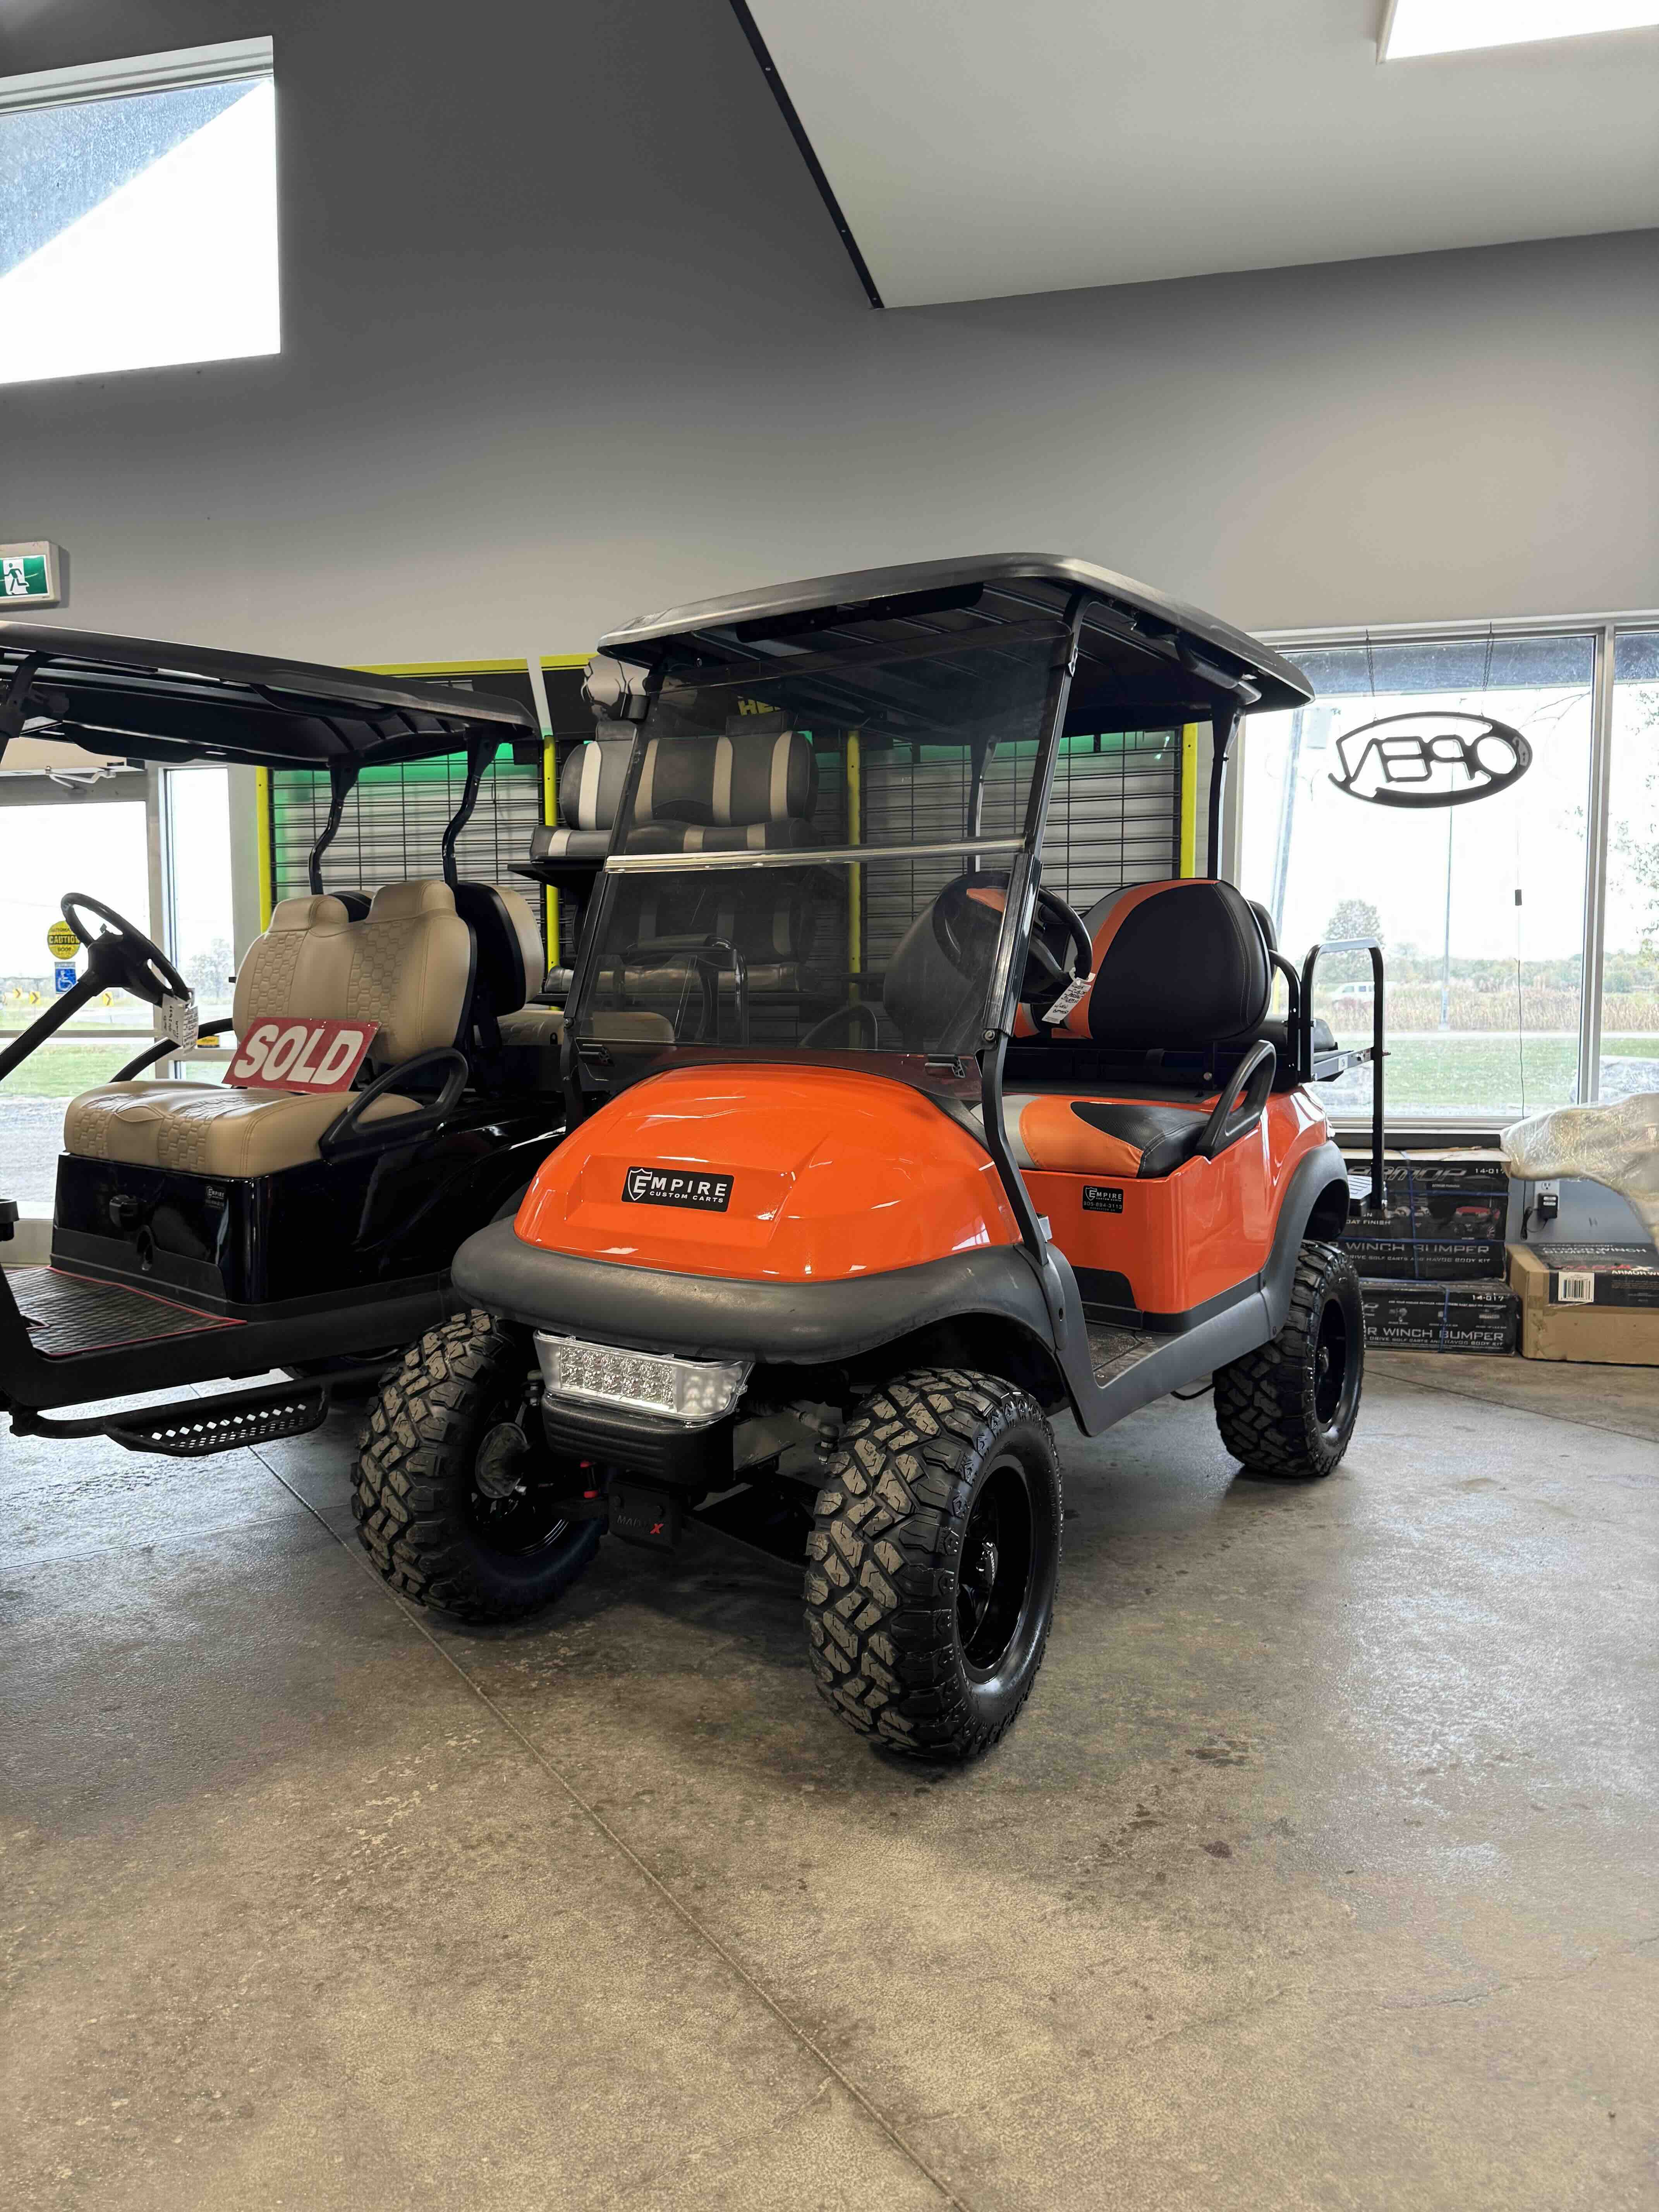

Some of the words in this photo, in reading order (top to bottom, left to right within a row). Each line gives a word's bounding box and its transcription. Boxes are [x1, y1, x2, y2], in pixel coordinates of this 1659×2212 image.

[234, 1024, 364, 1085] SOLD
[632, 1175, 727, 1197] EMPIRE
[649, 1190, 688, 1199] CUSTOM
[692, 1195, 724, 1203] CARTS
[1089, 1189, 1122, 1199] EMPIRE
[1345, 1242, 1406, 1251] WINCH
[1412, 1244, 1490, 1254] BUMPER
[1382, 1327, 1433, 1338] WINCH
[1439, 1329, 1504, 1341] BUMPER
